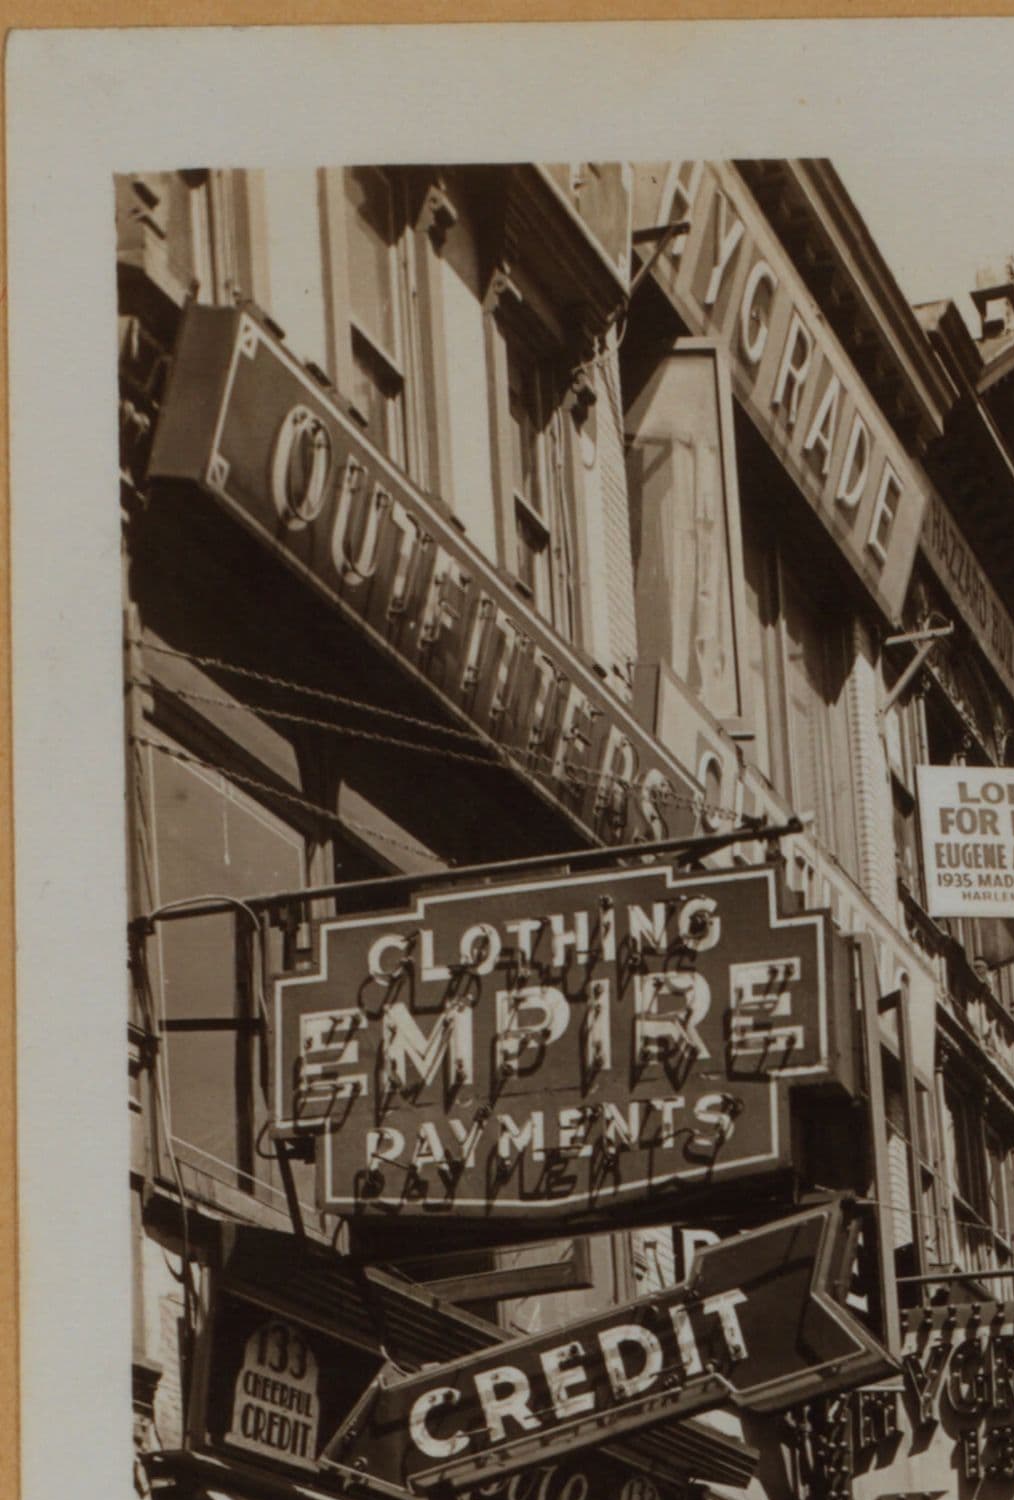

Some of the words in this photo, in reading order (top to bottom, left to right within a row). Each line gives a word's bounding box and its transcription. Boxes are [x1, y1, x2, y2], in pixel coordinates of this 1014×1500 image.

[939, 807, 1000, 835] FOR
[934, 842, 1008, 869] EUGENE
[937, 872, 972, 888] 1935
[366, 896, 722, 988] CLOTHING
[298, 956, 802, 1098] EMPIRE
[364, 1092, 745, 1178] PAYMENTS
[257, 1324, 308, 1380] 133
[409, 1286, 749, 1460] CREDIT
[241, 1402, 314, 1459] CREDIT
